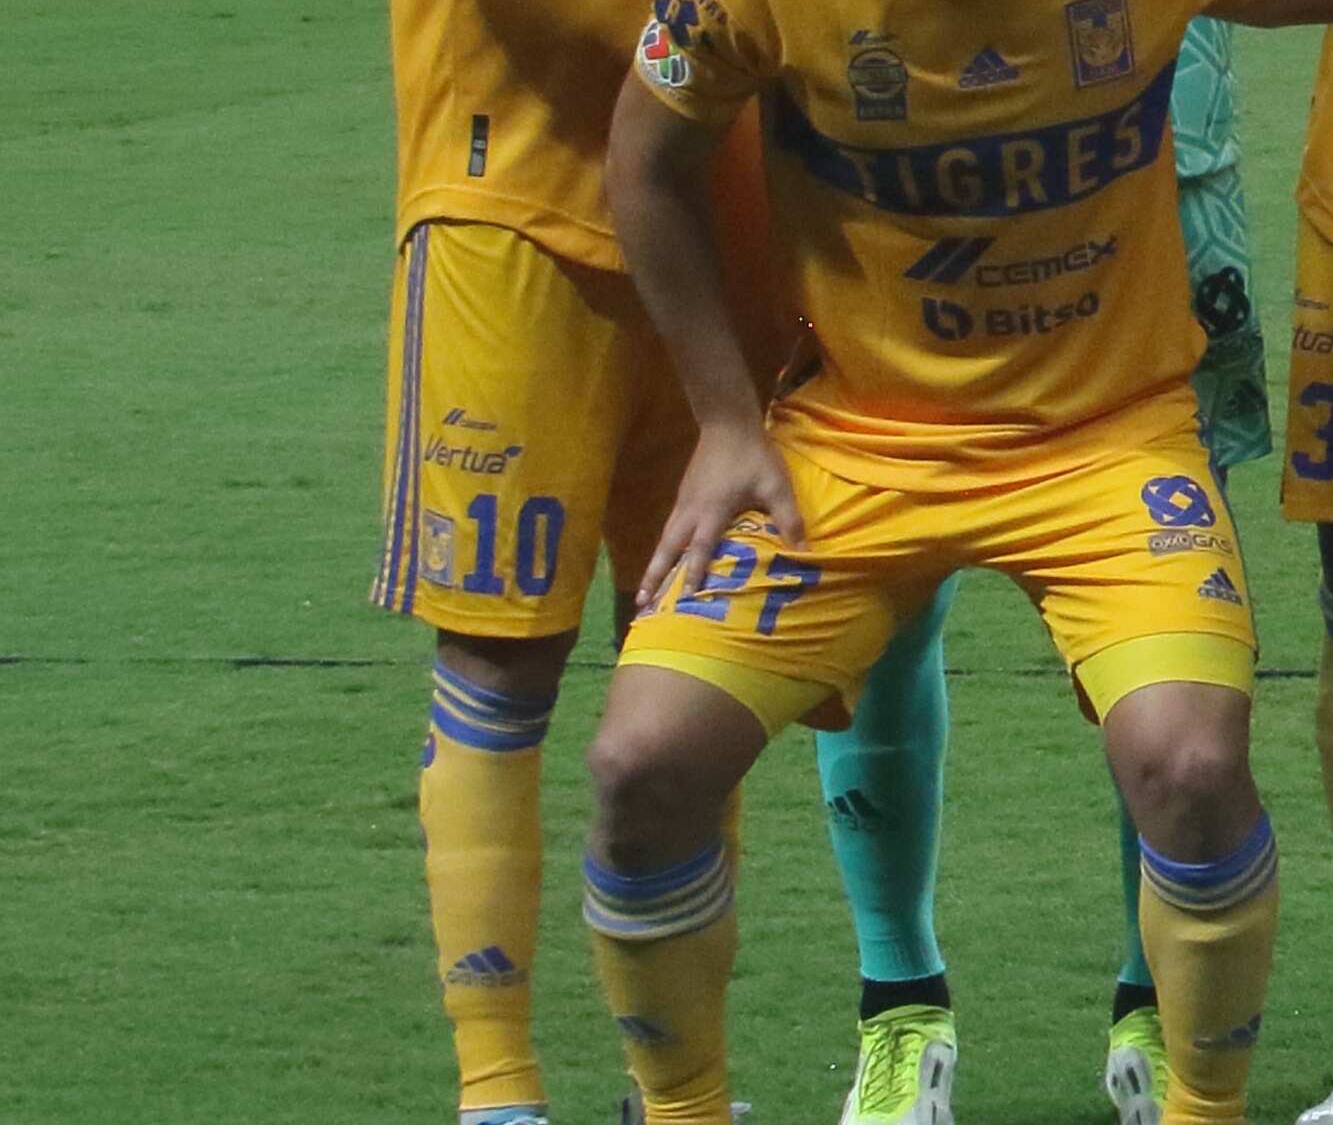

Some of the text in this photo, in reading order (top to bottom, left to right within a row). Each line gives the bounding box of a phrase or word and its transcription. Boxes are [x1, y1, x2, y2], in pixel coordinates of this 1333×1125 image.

[838, 98, 1143, 208] TIGRES
[975, 233, 1119, 288] CEMEX
[984, 290, 1101, 337] Bitso
[423, 434, 509, 475] Vertua
[463, 493, 566, 596] 10
[674, 538, 823, 636] 27
